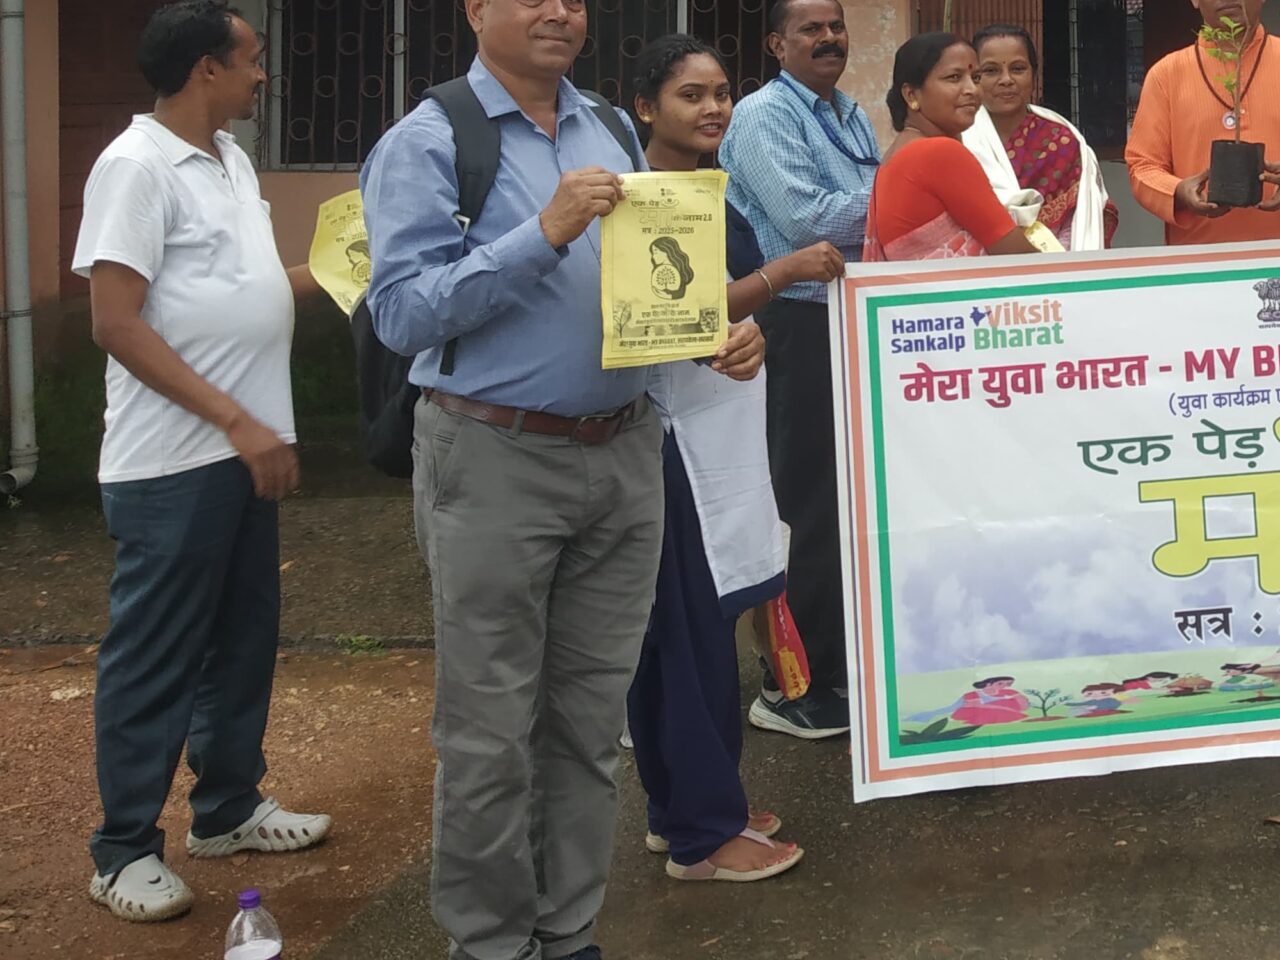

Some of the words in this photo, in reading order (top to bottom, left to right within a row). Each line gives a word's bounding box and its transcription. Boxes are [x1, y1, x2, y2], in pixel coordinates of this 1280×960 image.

[891, 315, 965, 335] Hamara
[985, 299, 1064, 328] Viksit
[891, 333, 966, 354] Sankalp
[974, 322, 1064, 350] Bharat
[900, 362, 973, 403] मेरा
[979, 363, 1046, 409] युवा
[1056, 355, 1149, 391] भारत
[1183, 347, 1241, 382] MY
[1169, 392, 1208, 418] (युवा
[1213, 385, 1271, 409] कार्यक्रम
[1077, 435, 1174, 475] एक
[1192, 419, 1267, 468] पेड़
[1174, 607, 1233, 641] सत्र
